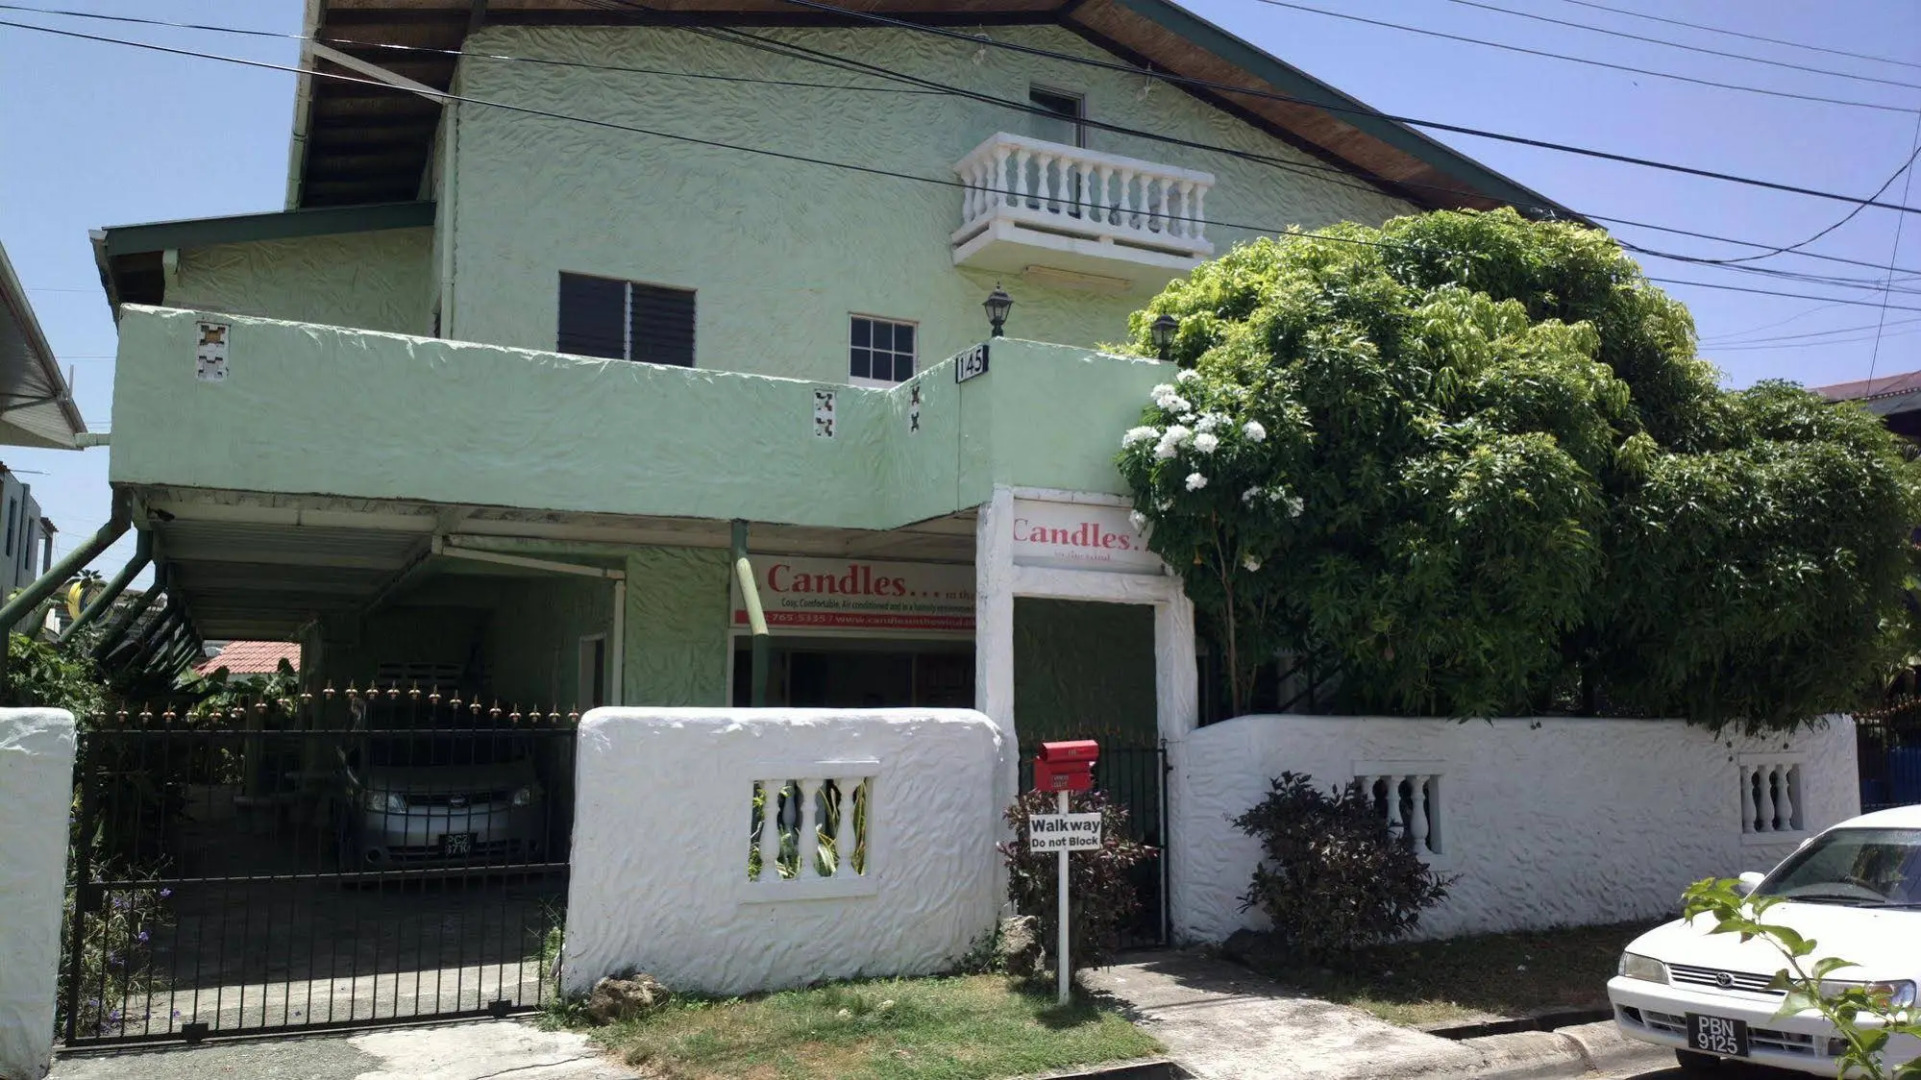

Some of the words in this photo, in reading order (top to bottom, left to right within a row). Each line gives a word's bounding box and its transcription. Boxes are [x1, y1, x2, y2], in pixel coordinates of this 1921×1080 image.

[960, 348, 982, 379] 145
[1031, 819, 1100, 834] Walkway
[1032, 838, 1046, 848] Do
[1049, 837, 1067, 847] not
[1069, 836, 1098, 847] Block
[1698, 1015, 1734, 1037] PBN
[1697, 1032, 1738, 1054] 9125
